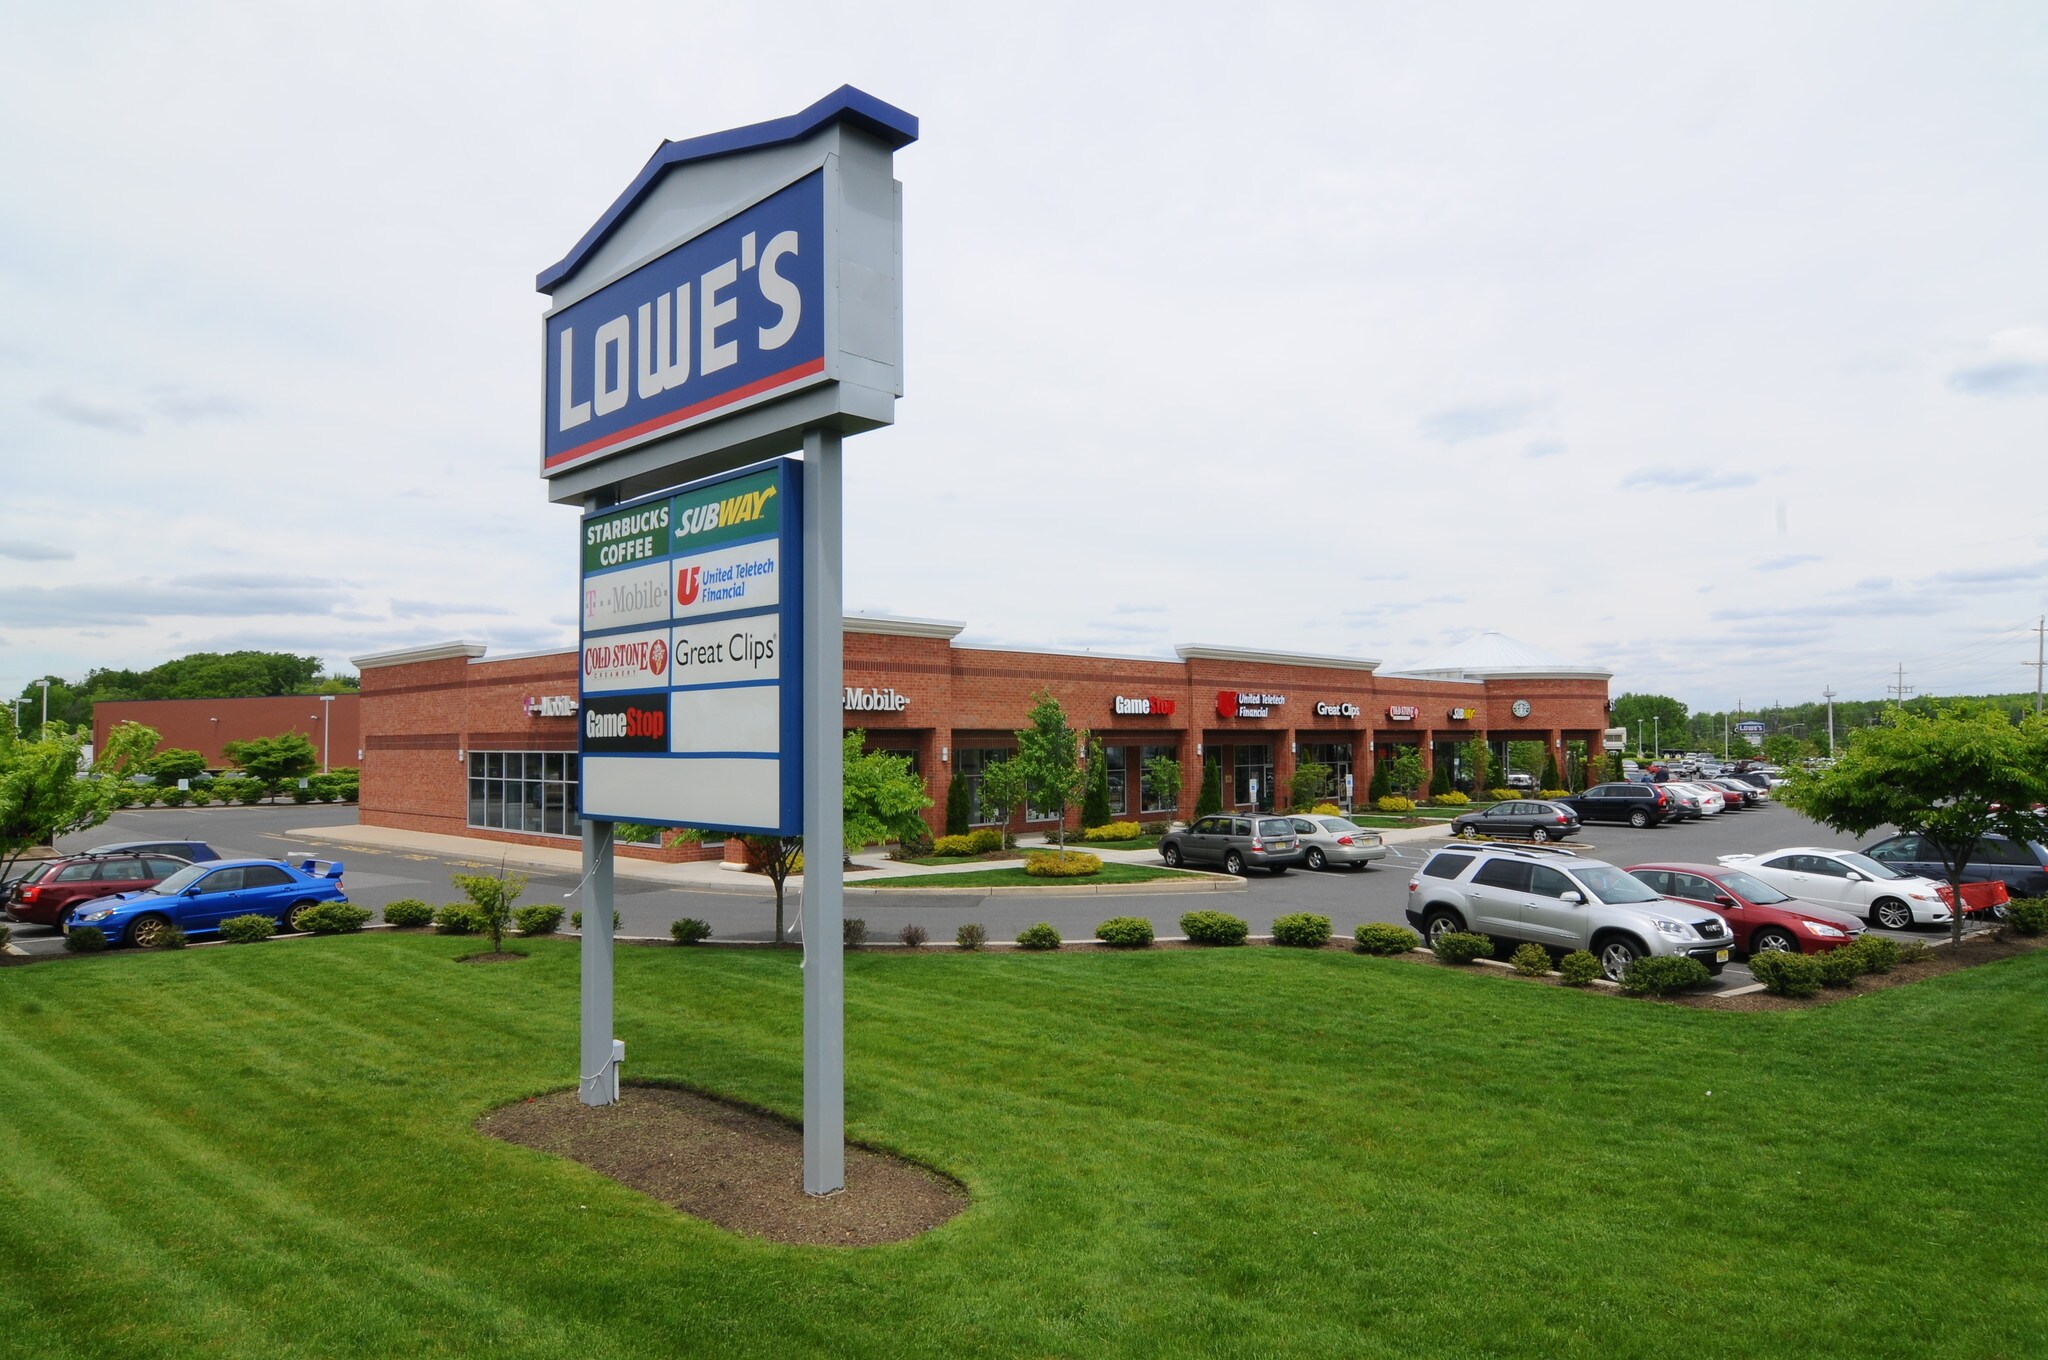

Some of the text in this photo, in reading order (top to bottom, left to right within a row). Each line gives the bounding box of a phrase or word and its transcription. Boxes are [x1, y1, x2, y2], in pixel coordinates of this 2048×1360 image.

[559, 230, 802, 432] LOWE'S
[587, 506, 669, 545] STARBUCKS
[674, 484, 777, 538] SUBWAY
[600, 536, 653, 566] COFFEE
[702, 558, 774, 586] United Teletech
[702, 581, 745, 603] Financial
[585, 642, 649, 676] COLD STONE
[675, 632, 774, 669] Great Clips
[594, 669, 637, 679] CREAMERY
[1115, 695, 1175, 716] GameStop
[1238, 693, 1261, 705] United
[1261, 694, 1285, 705] Teletech
[1239, 707, 1269, 718] Financial
[1317, 701, 1340, 716] Great
[586, 706, 664, 740] GameStop
